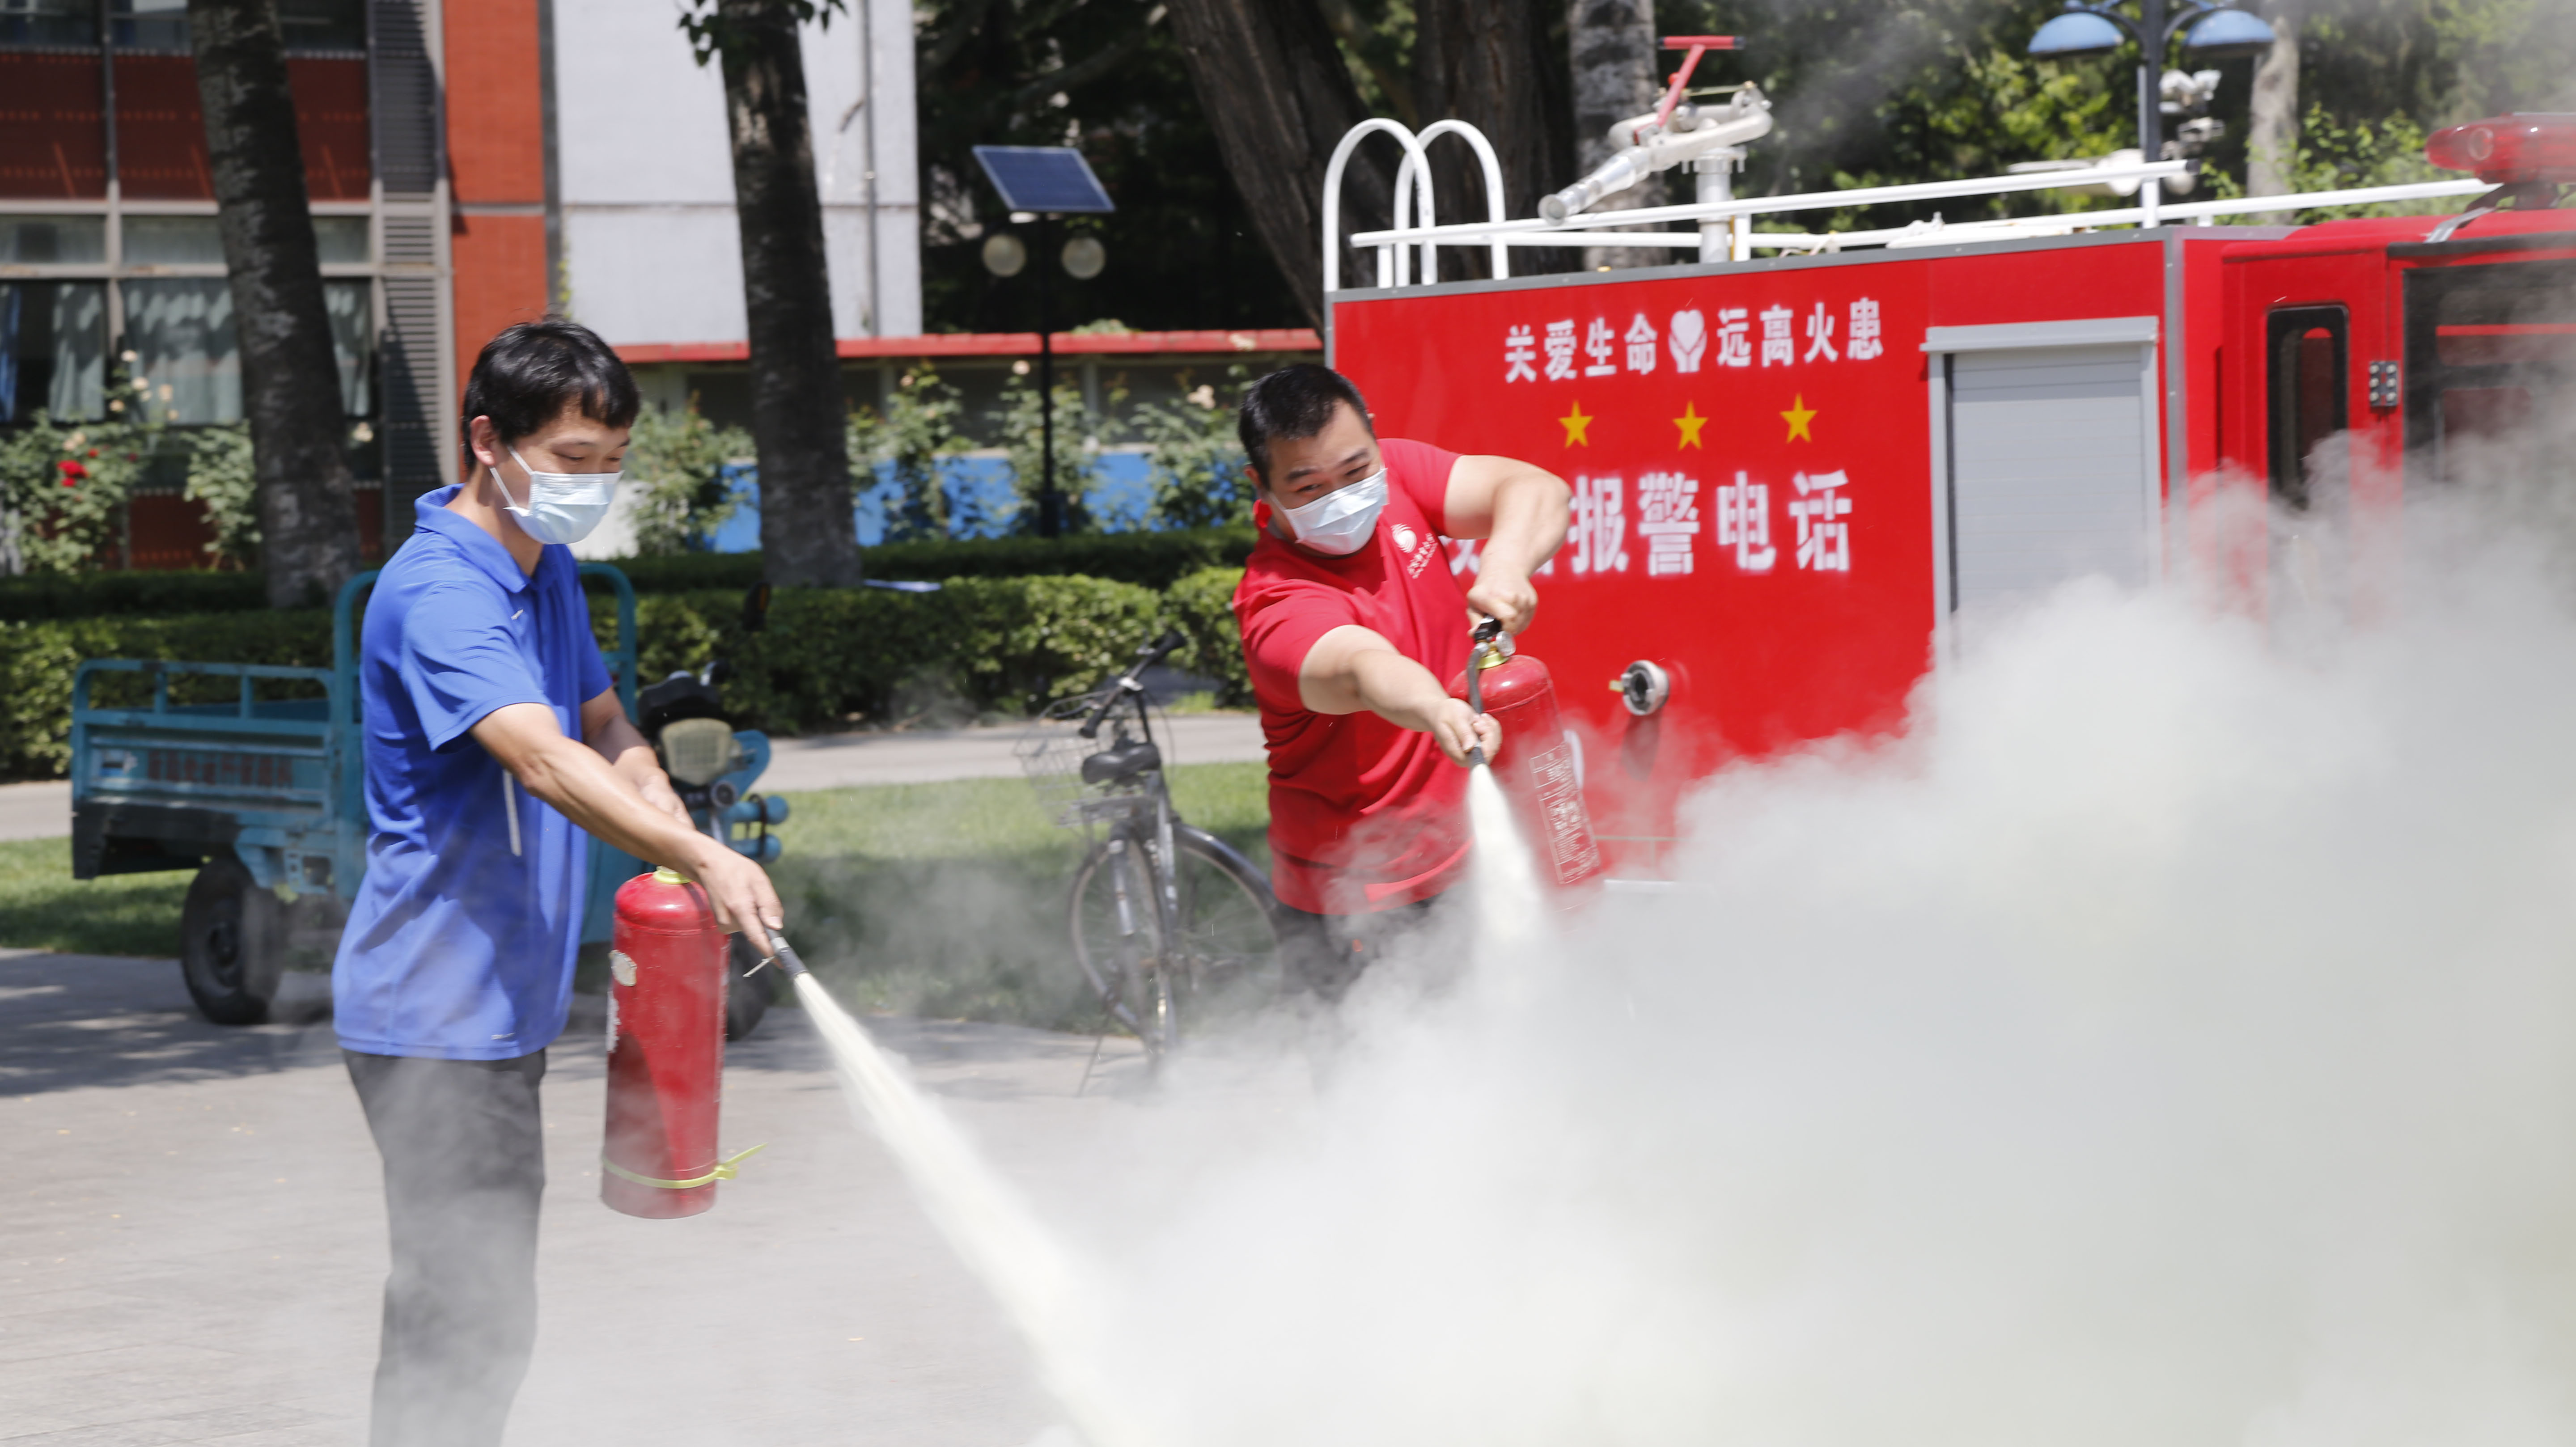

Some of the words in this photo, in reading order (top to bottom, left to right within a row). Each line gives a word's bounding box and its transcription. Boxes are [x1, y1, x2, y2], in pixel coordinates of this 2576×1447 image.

[1504, 313, 1658, 383] 关爱生命
[1717, 297, 1884, 368] 远离火患
[1438, 469, 1852, 577] 报警电话
